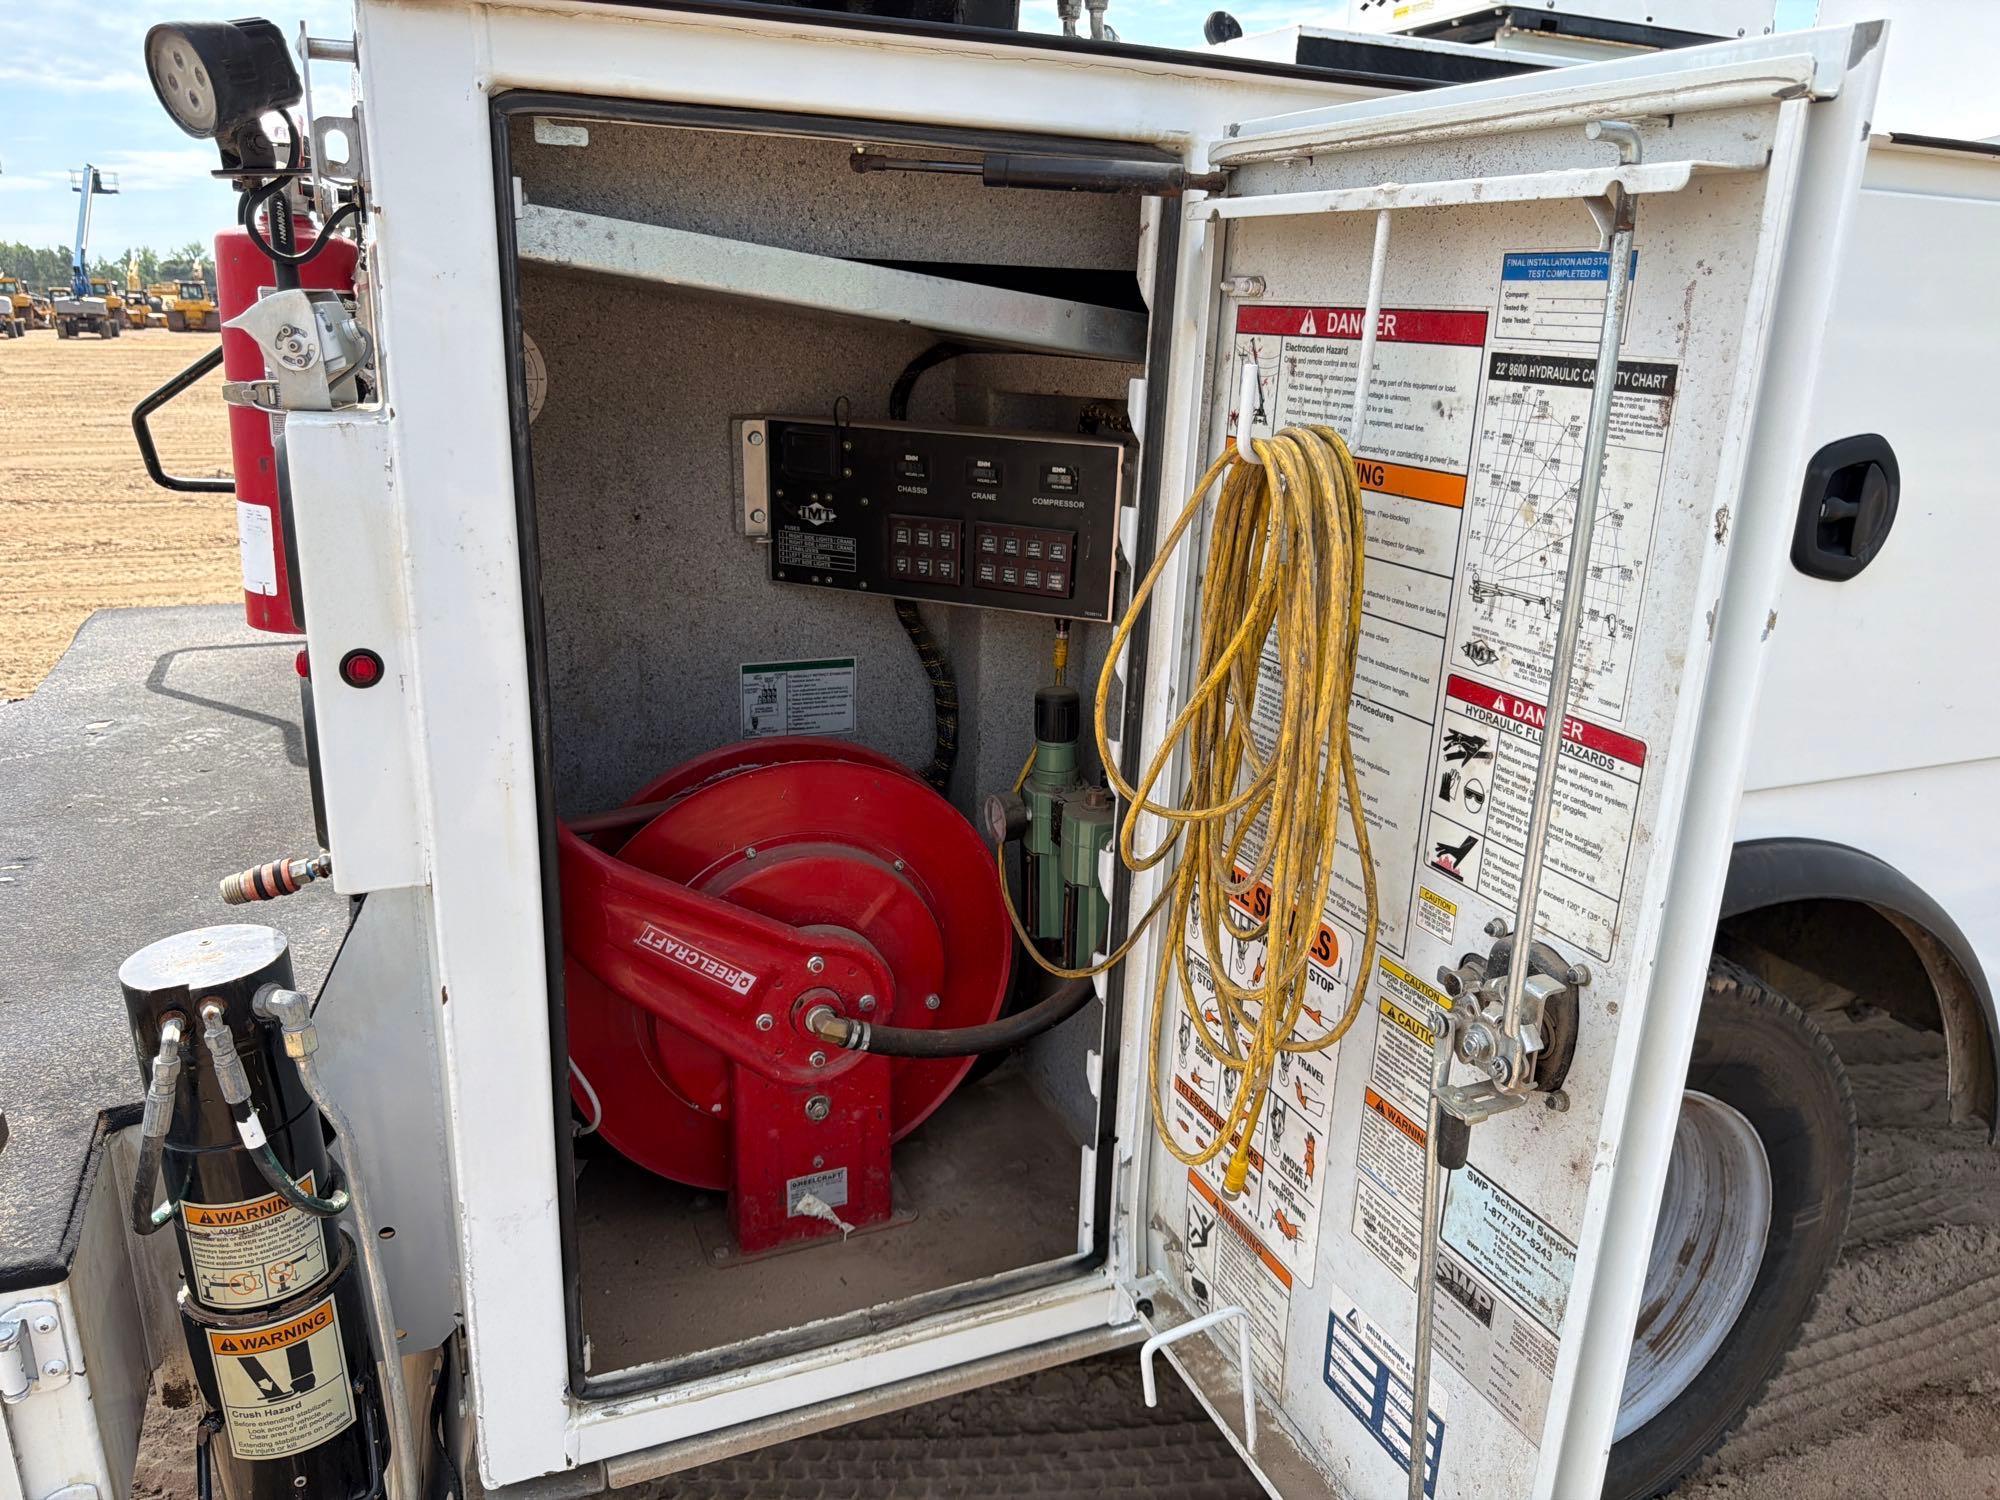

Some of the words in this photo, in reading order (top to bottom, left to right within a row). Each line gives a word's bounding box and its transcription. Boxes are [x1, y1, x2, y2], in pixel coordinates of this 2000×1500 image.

[1507, 258, 1526, 267] FINAL
[1527, 257, 1575, 267] INSTALLATION
[1576, 257, 1592, 266] AND
[1528, 269, 1545, 278] TEST
[1546, 269, 1590, 278] COMPLETED
[1591, 269, 1604, 278] BY:
[1327, 312, 1396, 336] DANER
[1285, 343, 1325, 355] Electrocution
[1326, 345, 1349, 356] Hazard
[1387, 380, 1397, 390] part
[1412, 383, 1437, 393] equipment
[1495, 362, 1508, 375] 22'
[1509, 363, 1528, 380] 8600
[1529, 365, 1580, 381] HYDRAULIC
[1632, 376, 1667, 389] CHART
[1396, 450, 1422, 462] contacting
[1429, 456, 1445, 466] power
[897, 485, 928, 495] CHASSIS
[971, 492, 997, 501] CRANE
[800, 505, 835, 523] IMT
[1032, 497, 1085, 509] COMPRESSOR
[1405, 601, 1419, 610] boom
[1426, 606, 1436, 616] load
[1375, 659, 1399, 673] subtracted
[1400, 665, 1410, 675] from
[1419, 672, 1430, 684] load
[1512, 658, 1526, 668] IOWA
[1527, 661, 1543, 673] MOLD
[1360, 676, 1379, 687] reduced
[1380, 681, 1392, 691] boom
[1356, 699, 1395, 723] Procedures
[1513, 700, 1583, 741] DANER
[1465, 704, 1524, 736] HYDRAULIC
[1561, 743, 1615, 771] HAZARDS
[1499, 751, 1521, 766] Release
[1567, 782, 1594, 799] working
[1595, 790, 1603, 800] on
[1604, 795, 1629, 812] system.
[1569, 768, 1578, 777] will
[1578, 771, 1597, 786] pierce
[1599, 780, 1615, 792] skin.
[1494, 783, 1515, 797] NEVER
[1516, 793, 1527, 802] use
[1562, 803, 1589, 819] goggles.
[1570, 795, 1603, 815] cardboard.
[1485, 847, 1498, 859] Burn
[1565, 839, 1602, 862] immediately
[1574, 833, 1604, 853] surgically
[1482, 868, 1490, 877] Do
[1491, 872, 1500, 882] not
[1549, 856, 1560, 865] will
[1561, 860, 1577, 873] injure
[1578, 869, 1586, 878] or
[1424, 891, 1451, 911] CAUTION
[1543, 889, 1565, 905] exceed
[1566, 899, 1580, 912] 120°
[1538, 909, 1551, 922] skin.
[642, 932, 740, 985] REELCRAFT
[1308, 967, 1335, 994] STOP
[1381, 969, 1398, 985] AVOID
[1399, 981, 1435, 1009] EQUIPMENT
[1404, 973, 1440, 1004] CAUTION
[1386, 979, 1404, 996] Check
[1404, 993, 1412, 1003] oil
[1413, 998, 1427, 1012] level
[1397, 1012, 1436, 1046] CAUTIO
[1195, 1044, 1213, 1069] BOOM
[1296, 1053, 1326, 1087] TRAVEL
[1176, 1098, 1195, 1121] EXTEND
[1196, 1118, 1211, 1138] BOOM
[1387, 1107, 1426, 1144] WARNIN
[1283, 1150, 1304, 1178] MOVE
[1279, 1160, 1309, 1193] SLOWLY
[1268, 1179, 1307, 1223] EVERYTHING
[1281, 1182, 1295, 1202] DOG
[215, 1198, 290, 1226] WARNIN
[1374, 1199, 1391, 1217] service
[1467, 1170, 1488, 1191] SWP
[1490, 1187, 1536, 1230] Technical
[1536, 1224, 1577, 1263] Support
[219, 1225, 249, 1236] AVOID
[250, 1215, 287, 1232] INJURY
[1220, 1205, 1264, 1257] WARNING
[1360, 1203, 1377, 1223] YOUR
[1377, 1219, 1418, 1261] AUTHORIZED
[1483, 1201, 1554, 1263] 1-877-737-5243
[234, 1240, 257, 1251] NEVER
[259, 1235, 281, 1246] extend
[1379, 1230, 1405, 1260] DEALER
[1437, 1252, 1494, 1311] SWP
[240, 1311, 327, 1351] WARNING
[1366, 1321, 1383, 1346] DELTA
[1382, 1340, 1407, 1367] RIGGING
[232, 1407, 262, 1421] Crush
[264, 1400, 303, 1418] Hazard
[233, 1417, 257, 1429] Before
[258, 1413, 296, 1429] extending
[239, 1436, 273, 1450] Extending
[274, 1429, 313, 1446] stabilizers
[314, 1422, 324, 1433] on
[324, 1410, 347, 1429] people
[248, 1425, 265, 1435] Look
[267, 1420, 294, 1433] around
[296, 1411, 324, 1426] vehicle.
[249, 1431, 268, 1442] Clear
[270, 1427, 288, 1439] area
[289, 1424, 298, 1435] of
[299, 1421, 308, 1433] all
[309, 1411, 336, 1429] people.
[239, 1447, 255, 1457] may
[256, 1443, 276, 1455] injure
[277, 1444, 285, 1452] or
